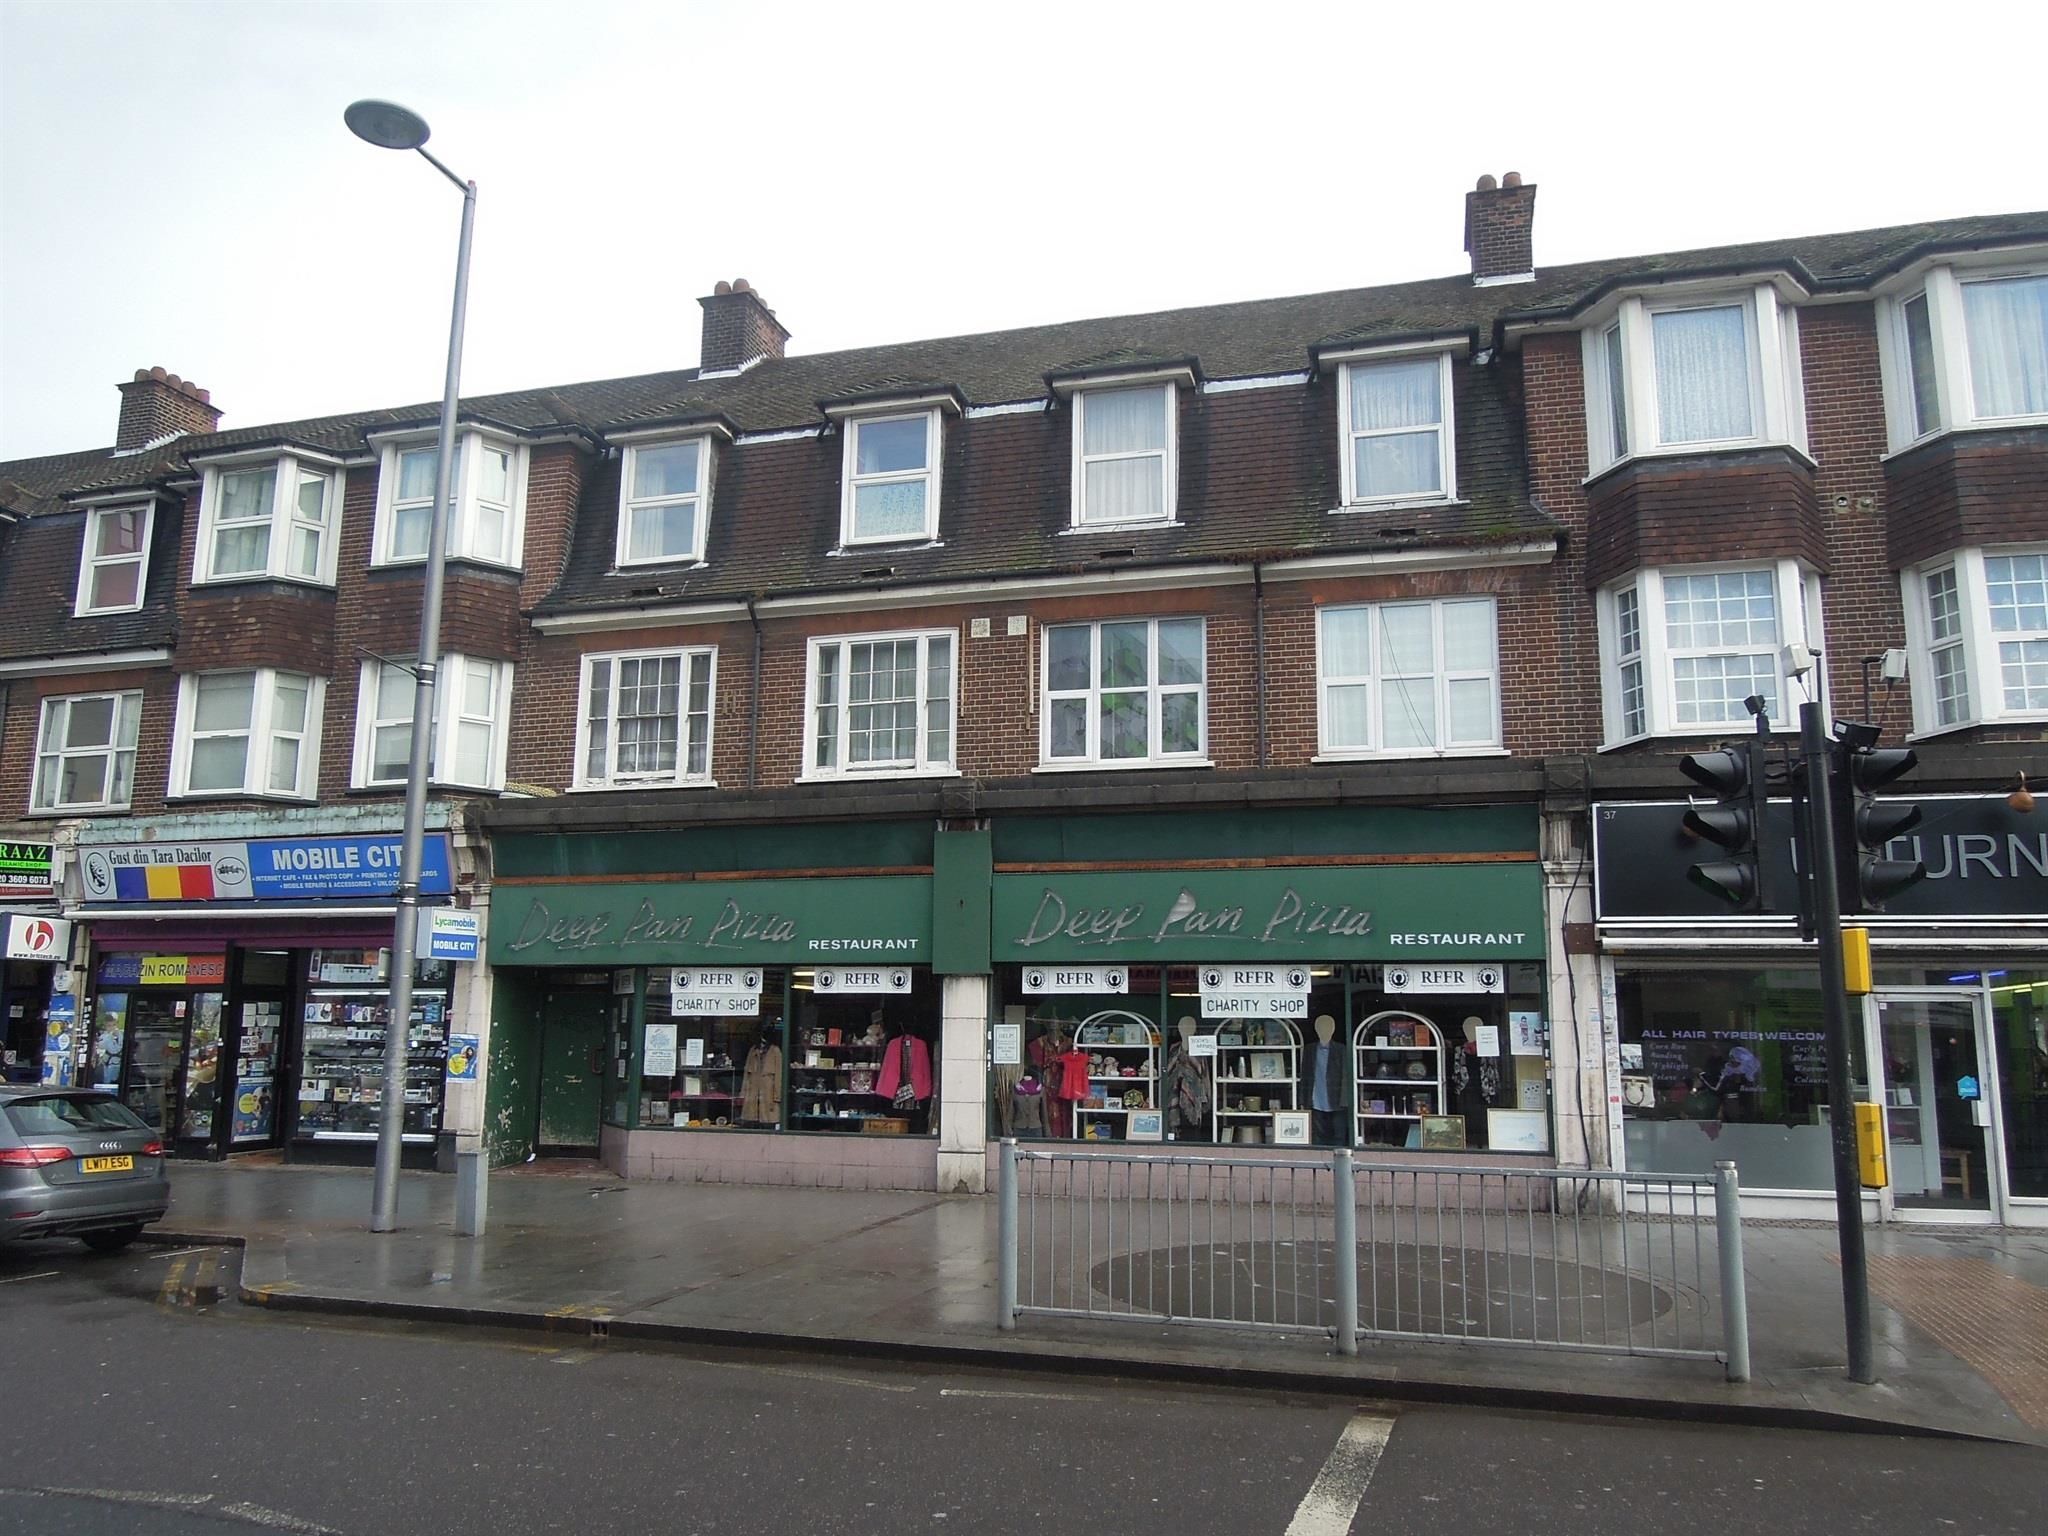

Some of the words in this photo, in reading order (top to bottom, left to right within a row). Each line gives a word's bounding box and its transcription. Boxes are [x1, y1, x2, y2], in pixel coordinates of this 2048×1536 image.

[1603, 810, 1617, 820] 37
[109, 850, 133, 865] Gust
[133, 849, 150, 864] din
[152, 849, 174, 864] Tara
[176, 847, 212, 863] Dacilor
[272, 847, 361, 871] MOBILE
[367, 845, 402, 868] CIT
[8, 875, 28, 883] 3609
[29, 876, 49, 885] 6078
[435, 915, 476, 928] Lycamobile
[1014, 888, 1146, 946] Deep
[1150, 887, 1244, 943] Pan
[1260, 886, 1373, 942] Pizza
[1390, 932, 1526, 945] RESTAURANT
[506, 897, 612, 951] Deep
[619, 896, 693, 947] Pan
[704, 897, 798, 948] Pizza
[809, 938, 919, 950] RESTAURANT
[433, 940, 459, 950] MOBILE
[460, 942, 475, 951] CITY
[105, 963, 155, 977] MAGAZIN
[159, 963, 224, 977] ROMANESC
[700, 973, 733, 985] RFFR
[845, 972, 881, 985] RFFR
[1056, 972, 1095, 985] RFFR
[1234, 971, 1276, 984] RFFR
[1421, 970, 1465, 984] RFFR
[676, 999, 721, 1010] CHARITY
[728, 999, 757, 1011] SHOP
[1206, 1000, 1260, 1012] CHARITY
[1270, 999, 1305, 1012] SHOP
[1641, 1029, 1667, 1038] ALL
[1672, 1030, 1706, 1039] HAIR
[1713, 1031, 1758, 1040] TYPES
[1765, 1032, 1826, 1041] WELCOM
[86, 1158, 108, 1170] LW17
[110, 1157, 129, 1169] ESG
